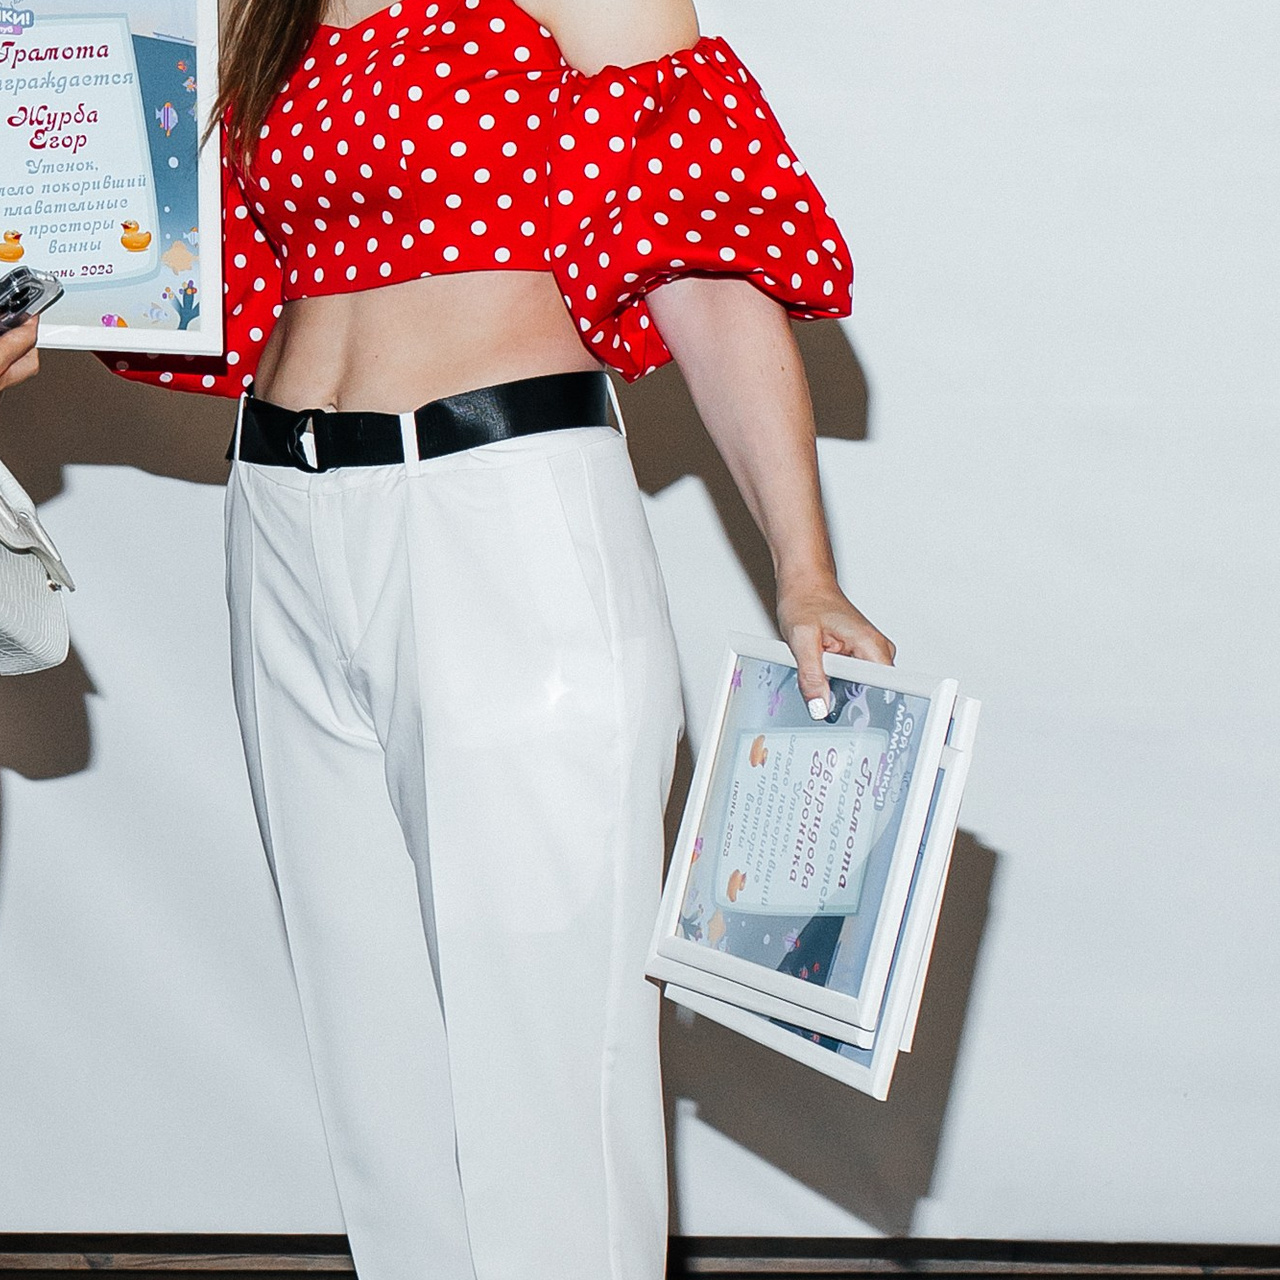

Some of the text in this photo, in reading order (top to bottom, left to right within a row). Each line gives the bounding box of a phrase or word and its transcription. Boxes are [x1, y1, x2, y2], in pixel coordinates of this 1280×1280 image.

[6, 103, 99, 132] Журба
[29, 128, 88, 154] Егор
[41, 175, 148, 195] покоривший
[3, 198, 128, 217] плавательные
[28, 220, 115, 239] просторы
[48, 239, 102, 254] ванны
[81, 264, 114, 277] 2023
[789, 750, 822, 882] Вероника
[800, 747, 837, 889] Свиридова
[838, 757, 871, 889] Грамота
